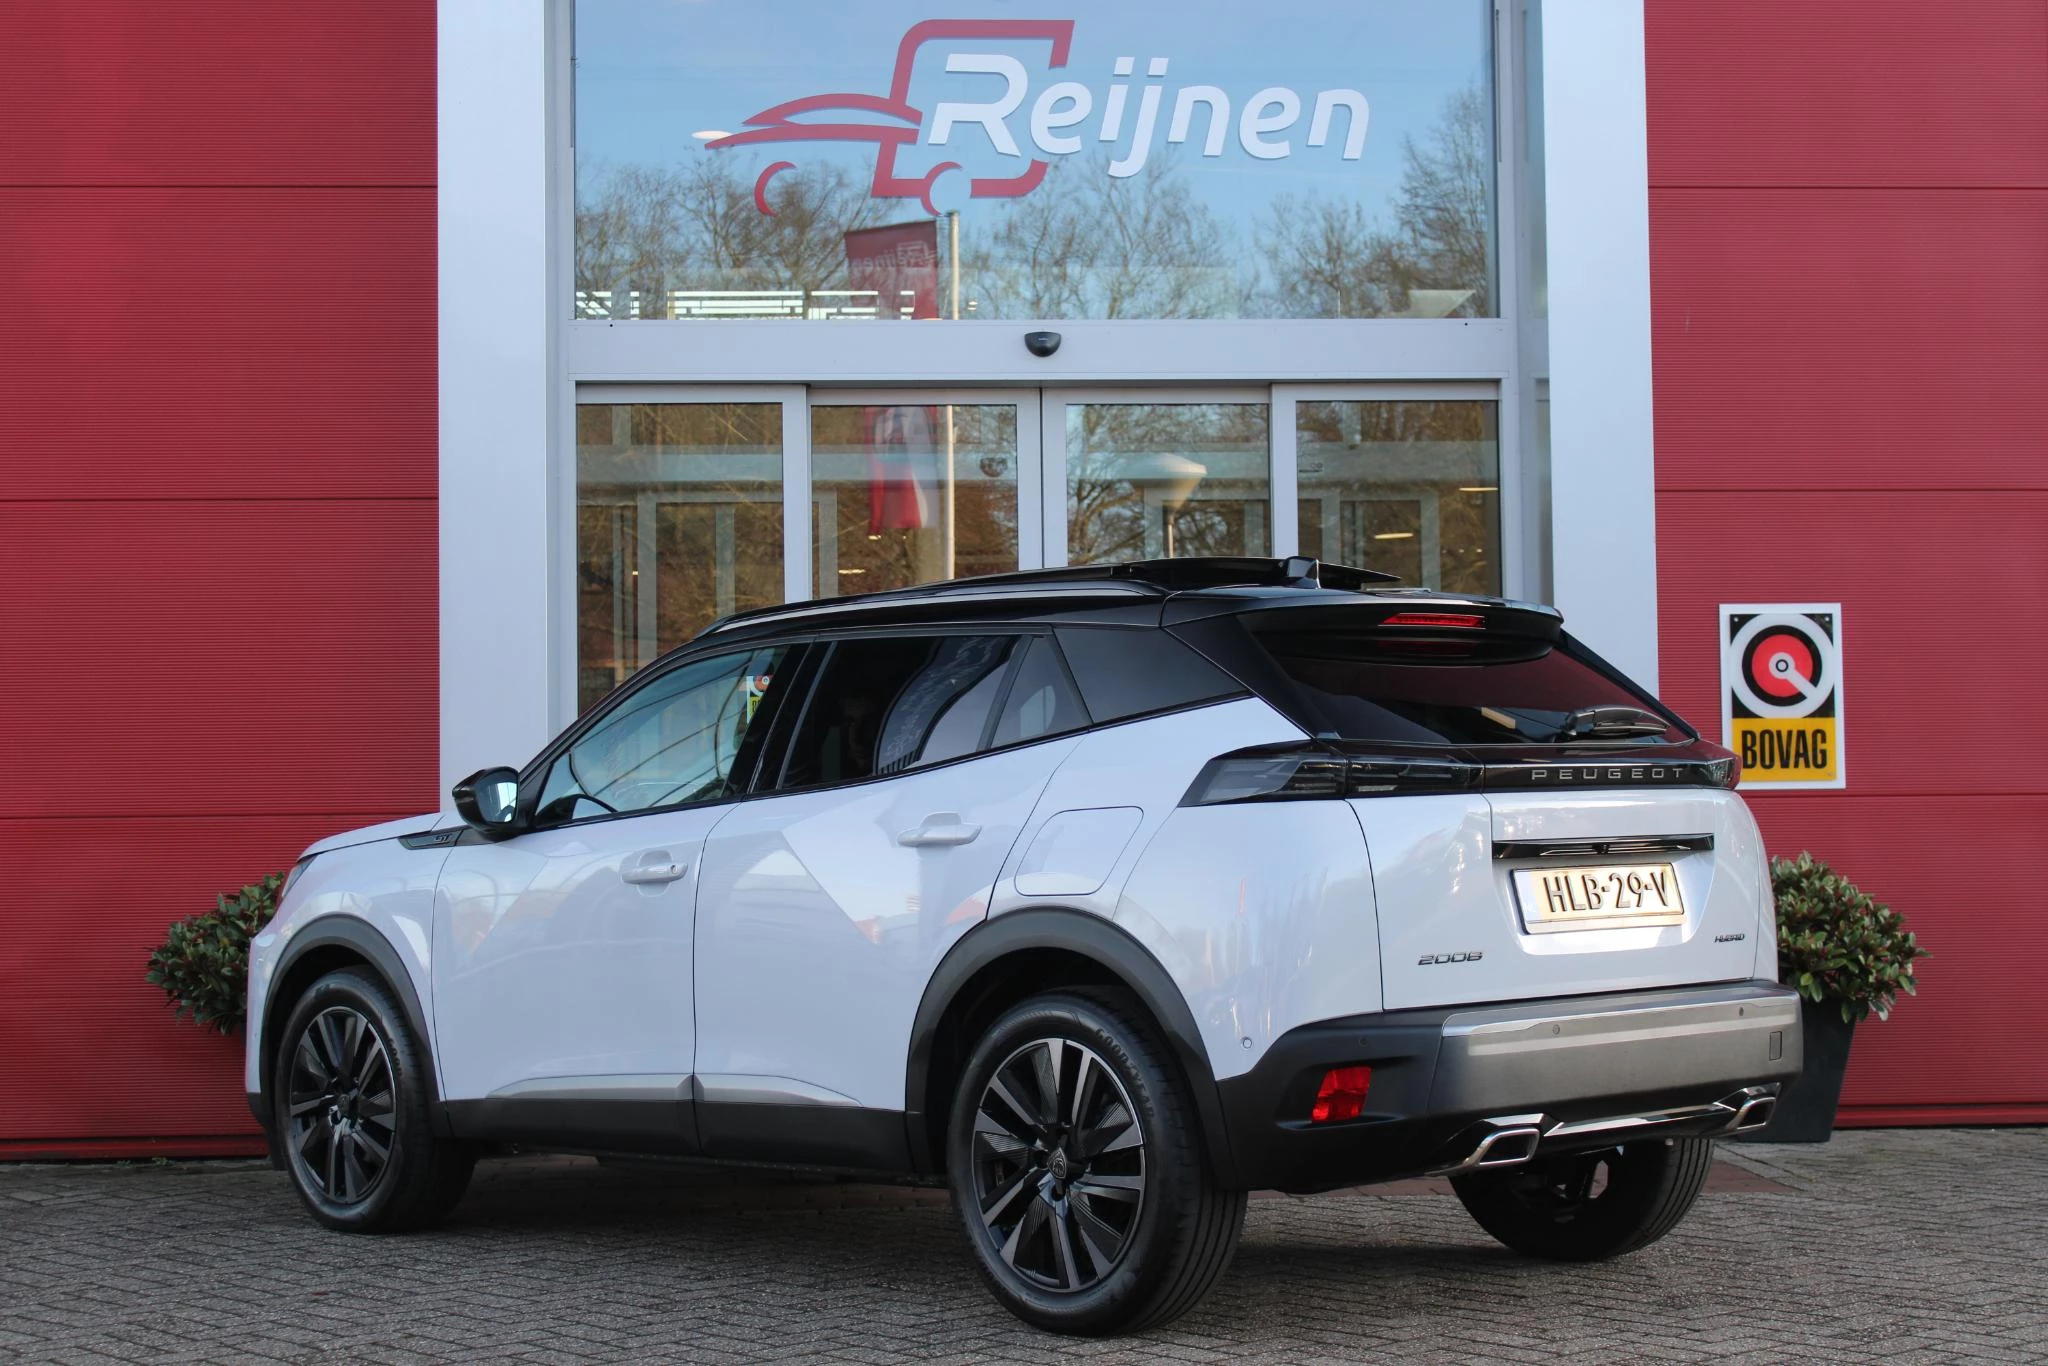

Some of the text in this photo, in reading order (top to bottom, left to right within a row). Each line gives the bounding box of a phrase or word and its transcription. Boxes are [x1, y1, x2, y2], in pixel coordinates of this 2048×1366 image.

[928, 53, 1370, 178] Reijnen
[1741, 729, 1827, 770] BOVAG
[1531, 767, 1684, 780] PEUGEOT
[1543, 871, 1669, 912] HLB-29-V
[1418, 951, 1483, 966] 2008
